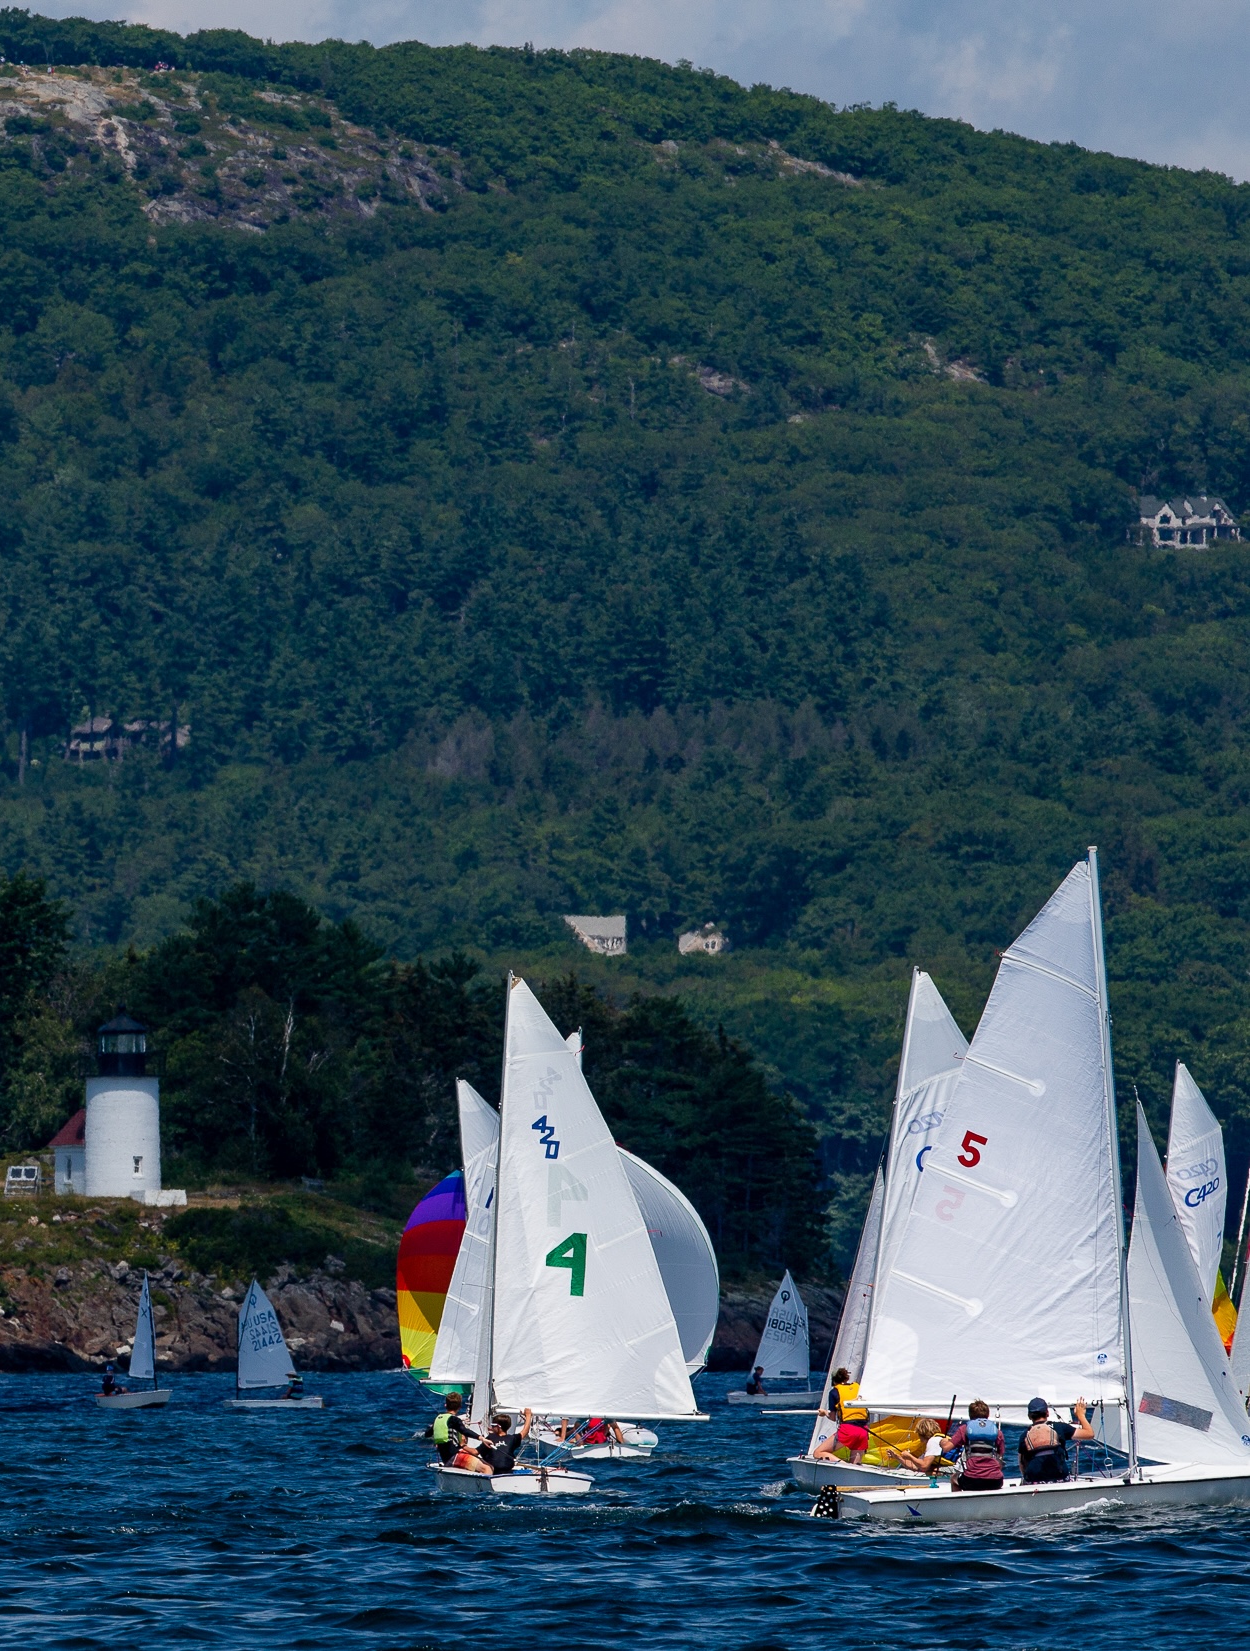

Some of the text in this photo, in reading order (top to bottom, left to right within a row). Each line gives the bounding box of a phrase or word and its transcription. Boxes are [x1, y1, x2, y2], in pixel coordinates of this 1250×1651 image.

[532, 1115, 560, 1159] 420
[957, 1130, 988, 1168] 5
[1185, 1178, 1219, 1207] C420
[546, 1233, 587, 1297] 4
[253, 1310, 274, 1326] USA
[768, 1318, 796, 1336] 18023
[252, 1333, 282, 1351] 21442
